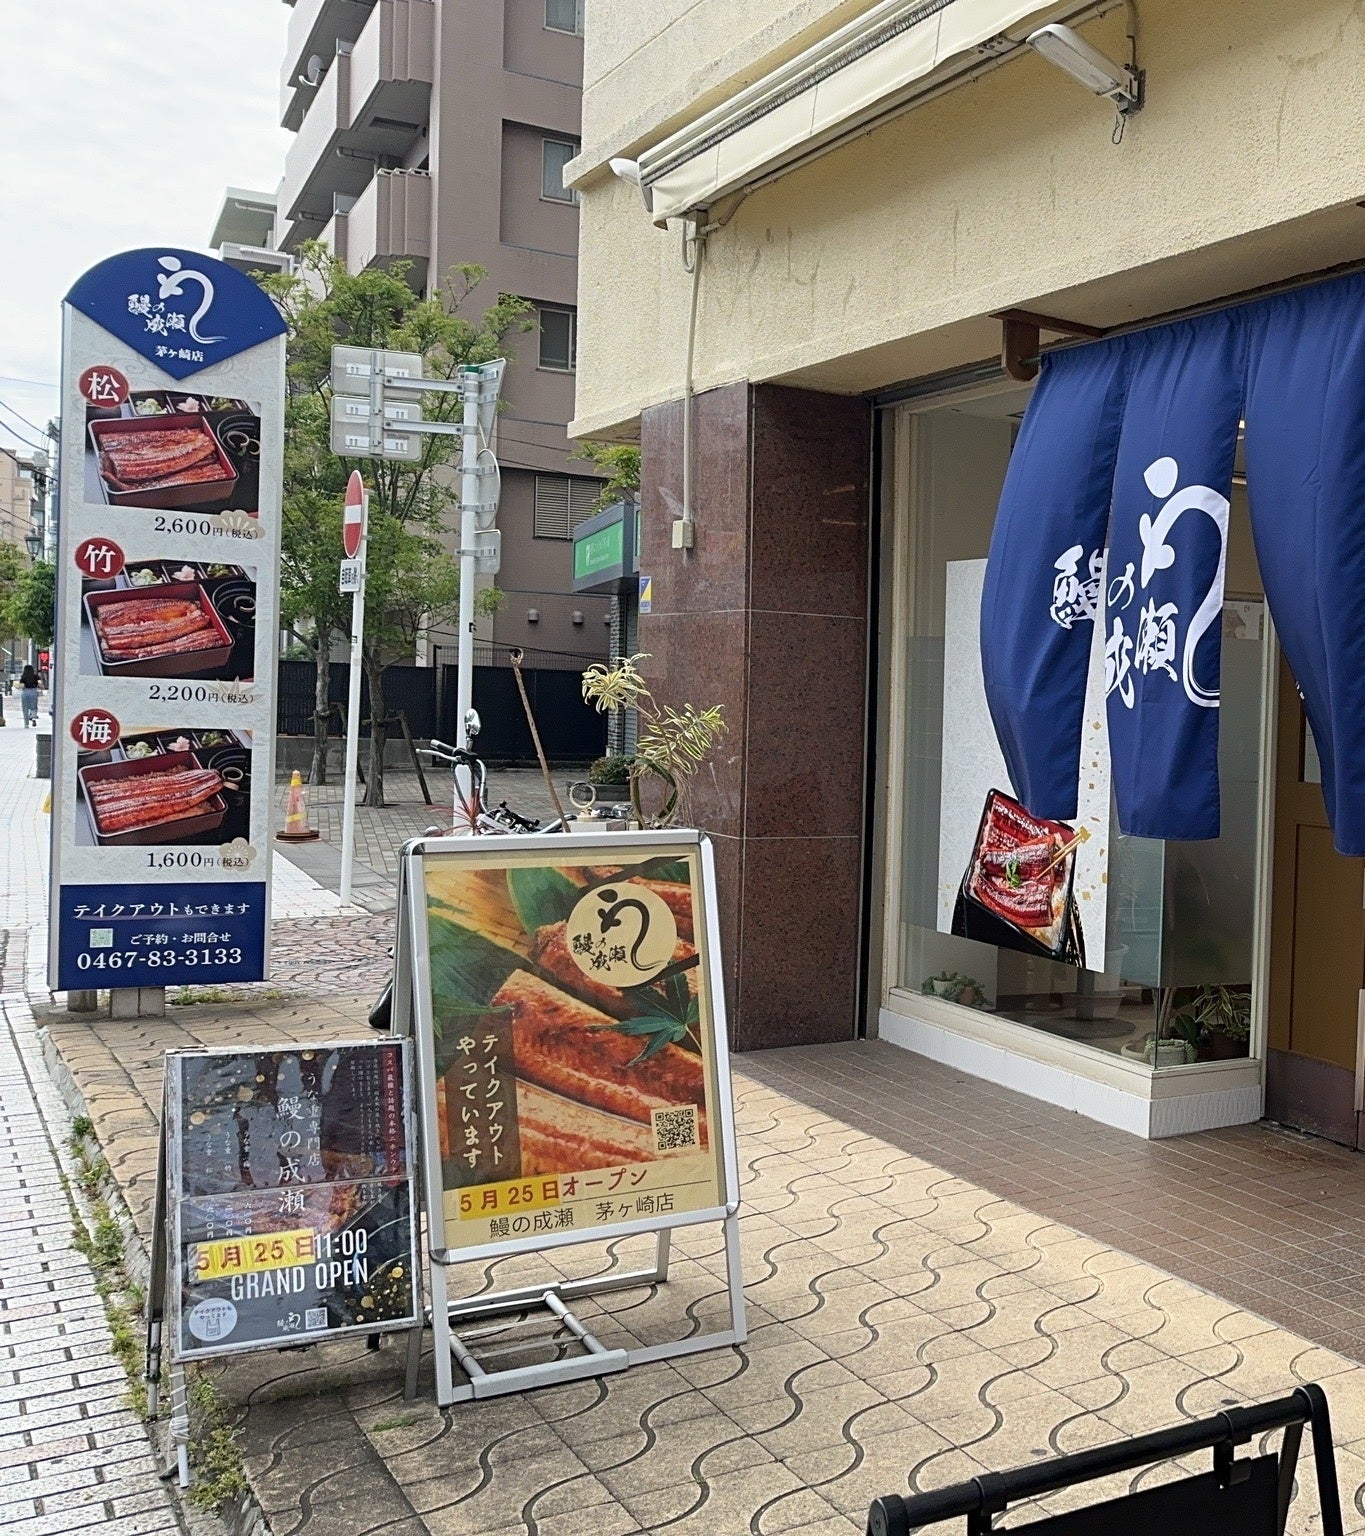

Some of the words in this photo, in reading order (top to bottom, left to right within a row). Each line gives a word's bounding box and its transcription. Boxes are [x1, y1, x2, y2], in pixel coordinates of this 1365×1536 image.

[87, 371, 121, 403] 松
[83, 543, 116, 574] 竹
[79, 716, 112, 745] 梅
[73, 902, 251, 920] テイクアウトもできます
[76, 948, 243, 970] 0467-83-3133
[456, 1035, 481, 1168] やっています
[482, 1033, 504, 1167] テイクアウト
[275, 1095, 306, 1214] 鰻の成瀬
[562, 1169, 648, 1199] オープン
[489, 1208, 575, 1239] 鰻の成瀬
[314, 1228, 368, 1259] 11:00
[231, 1266, 305, 1301] GRAND
[315, 1258, 369, 1290] OPEN
